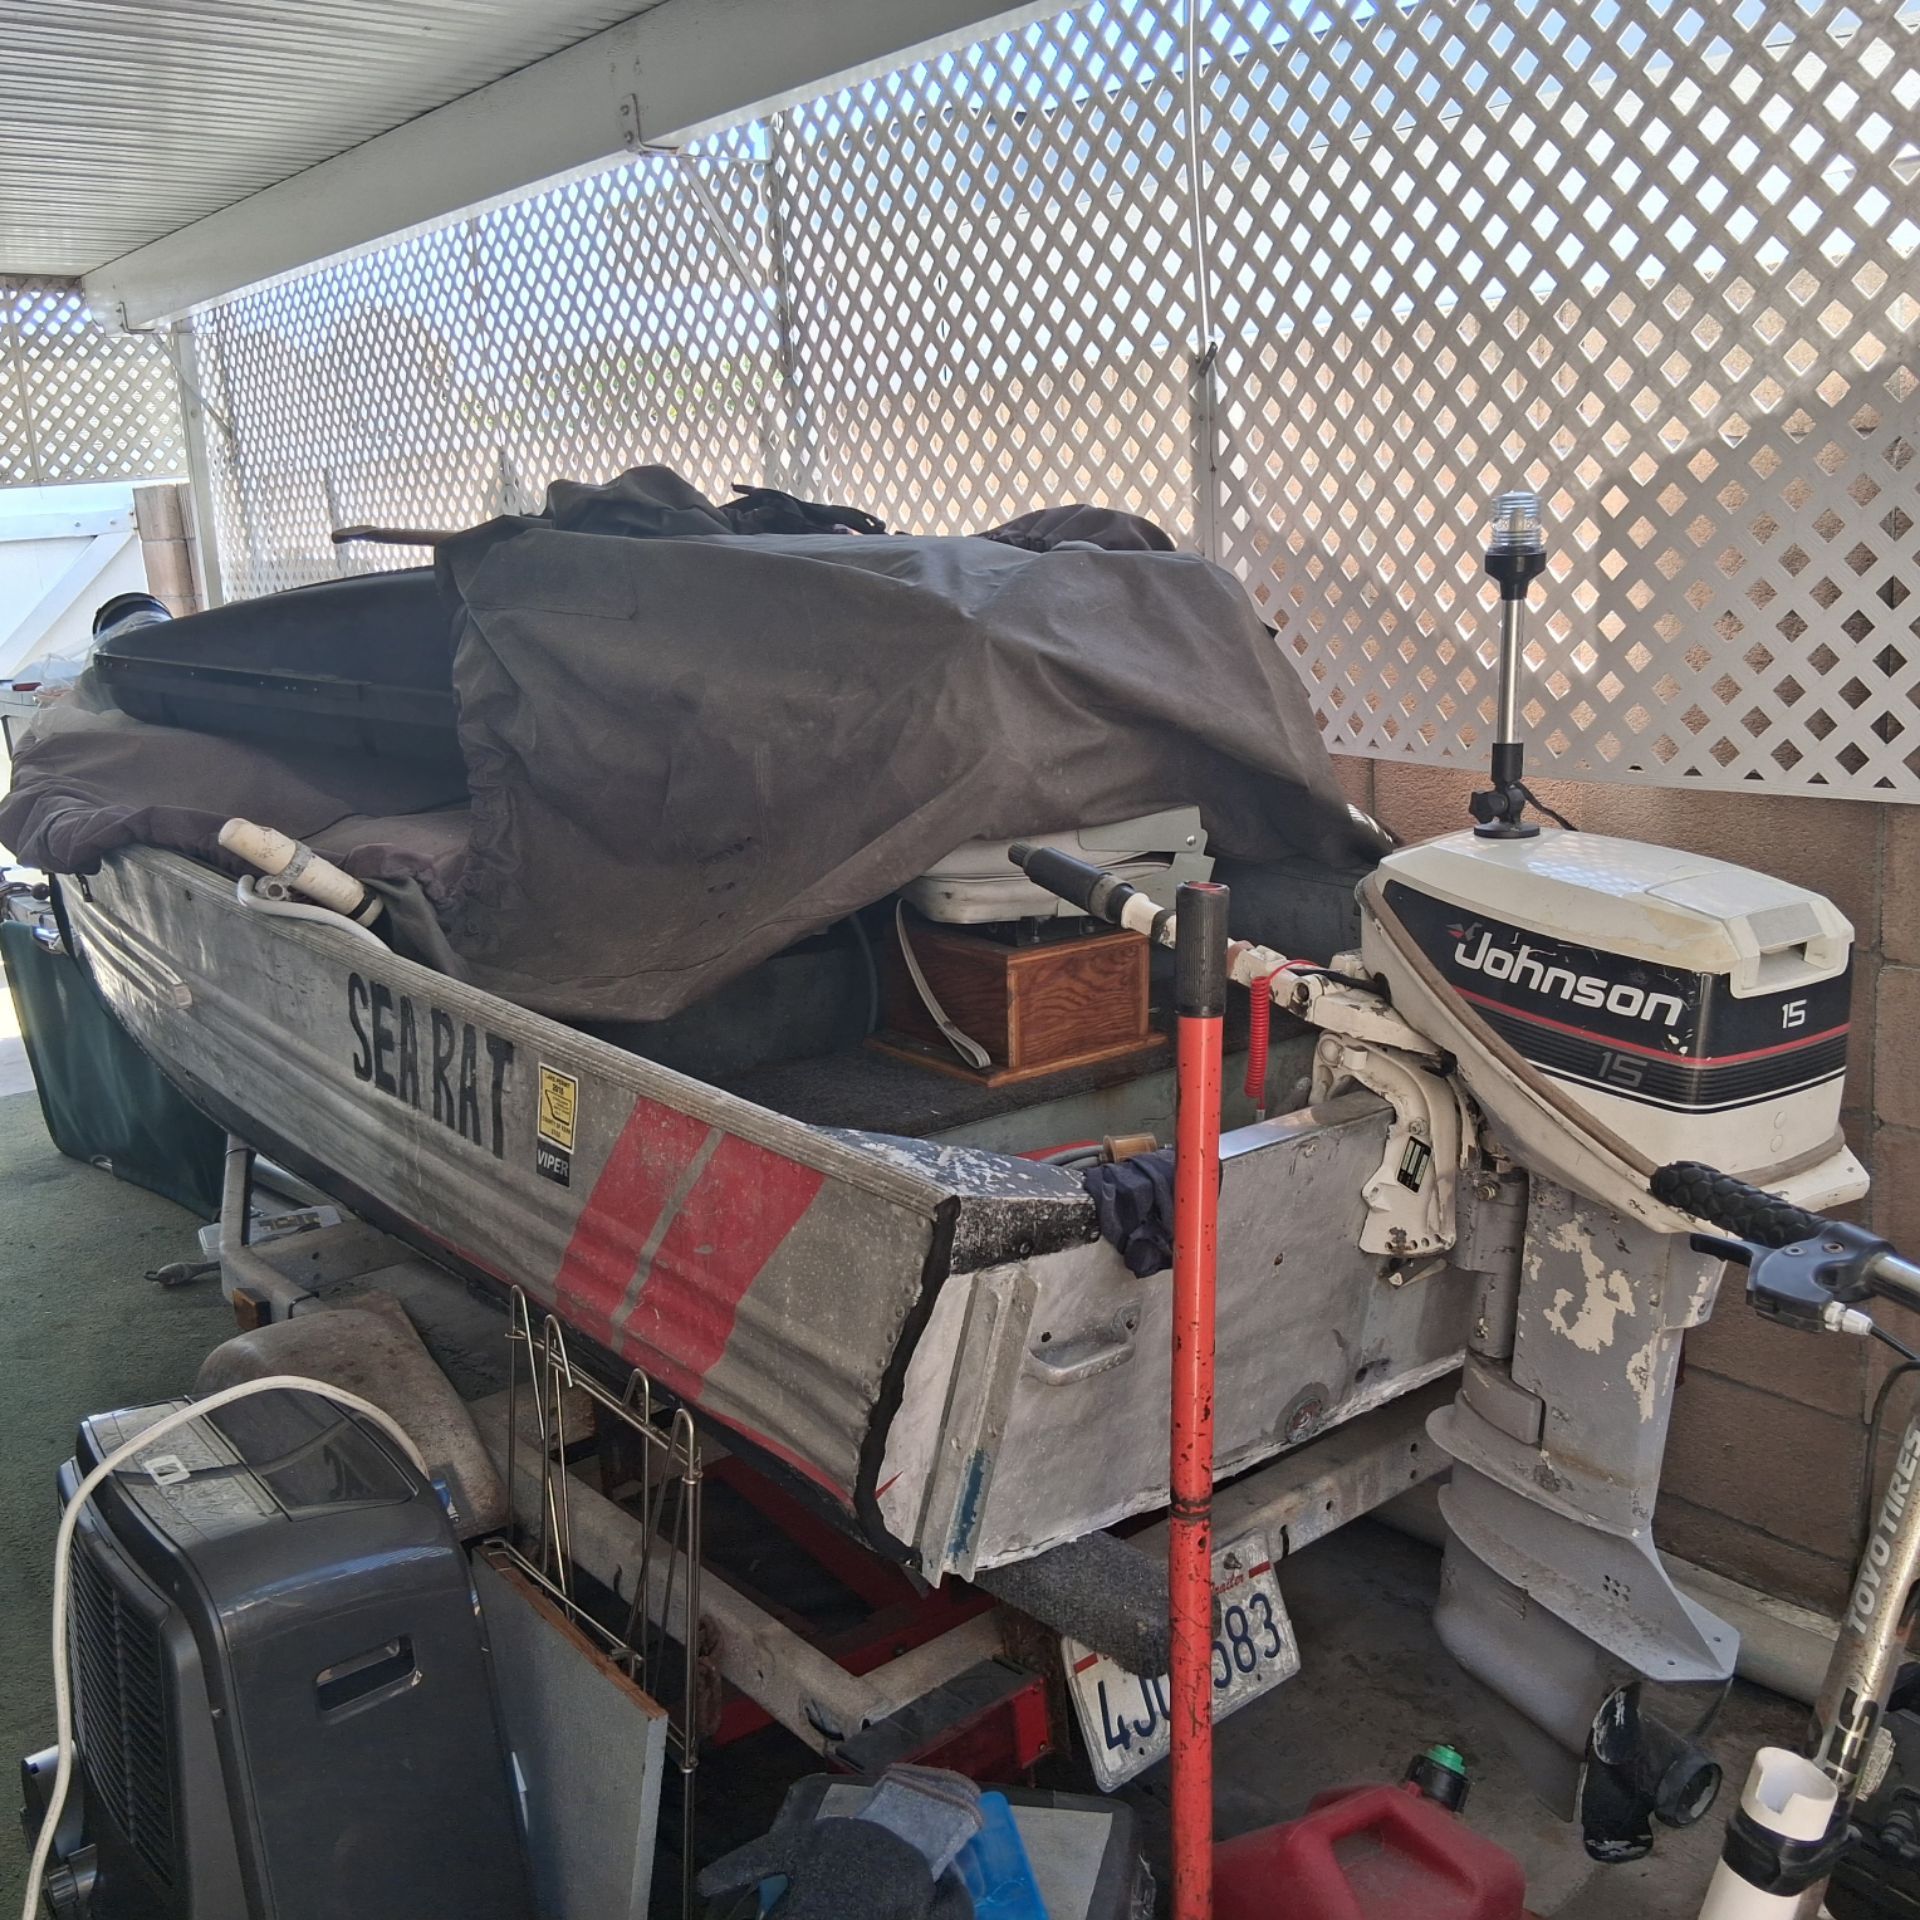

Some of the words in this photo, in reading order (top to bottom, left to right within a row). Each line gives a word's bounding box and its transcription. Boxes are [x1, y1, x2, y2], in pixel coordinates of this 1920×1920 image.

[1454, 933, 1684, 1027] Johnson
[1781, 1000, 1807, 1029] 15
[348, 972, 422, 1111] SEA
[430, 1007, 515, 1161] RAT
[1599, 1050, 1648, 1089] 15
[537, 1148, 569, 1178] VIPER
[1847, 1534, 1891, 1634] TOYO
[1877, 1428, 1920, 1534] TIRES
